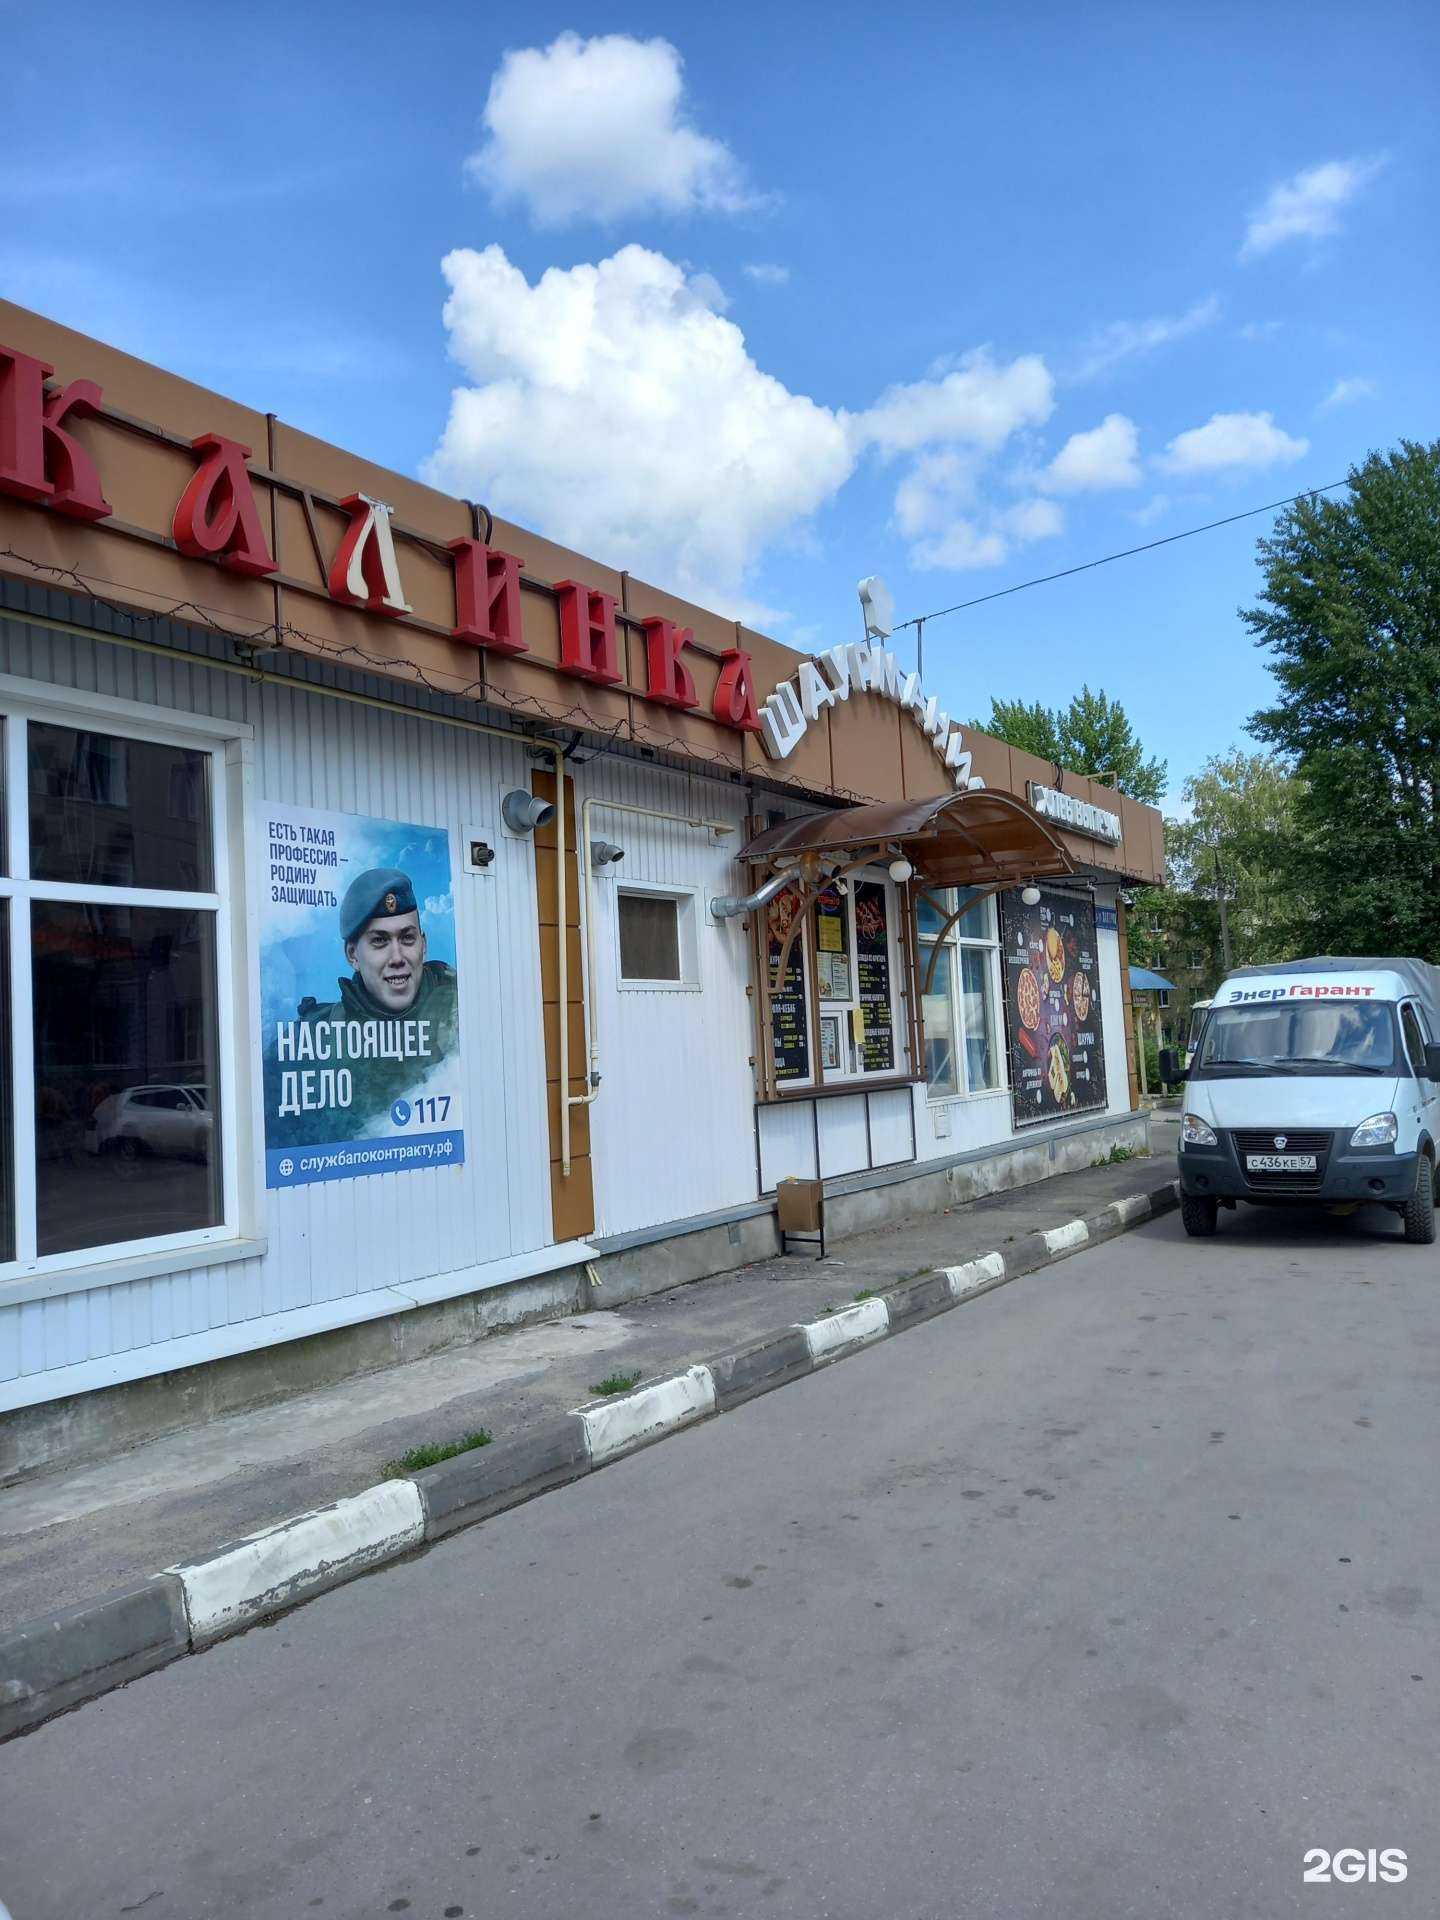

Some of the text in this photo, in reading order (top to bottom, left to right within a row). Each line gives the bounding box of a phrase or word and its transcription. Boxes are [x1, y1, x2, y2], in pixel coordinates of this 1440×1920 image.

[0, 345, 763, 732] КАЛИНКА
[269, 821, 335, 847] ЕСТЬ ТАКАЯ
[270, 843, 338, 867] ПРОФЕССИЯ
[271, 864, 316, 886] РОДИНУ
[272, 885, 338, 908] ЗАЩИЩАТЬ
[1229, 985, 1375, 1002] ЭнерГарант
[277, 1020, 432, 1062] НАСТОЯЩЕЕ
[278, 1069, 353, 1117] ДЕЛО
[414, 1096, 451, 1125] 117
[300, 1138, 454, 1171] службапоконтракту.рф
